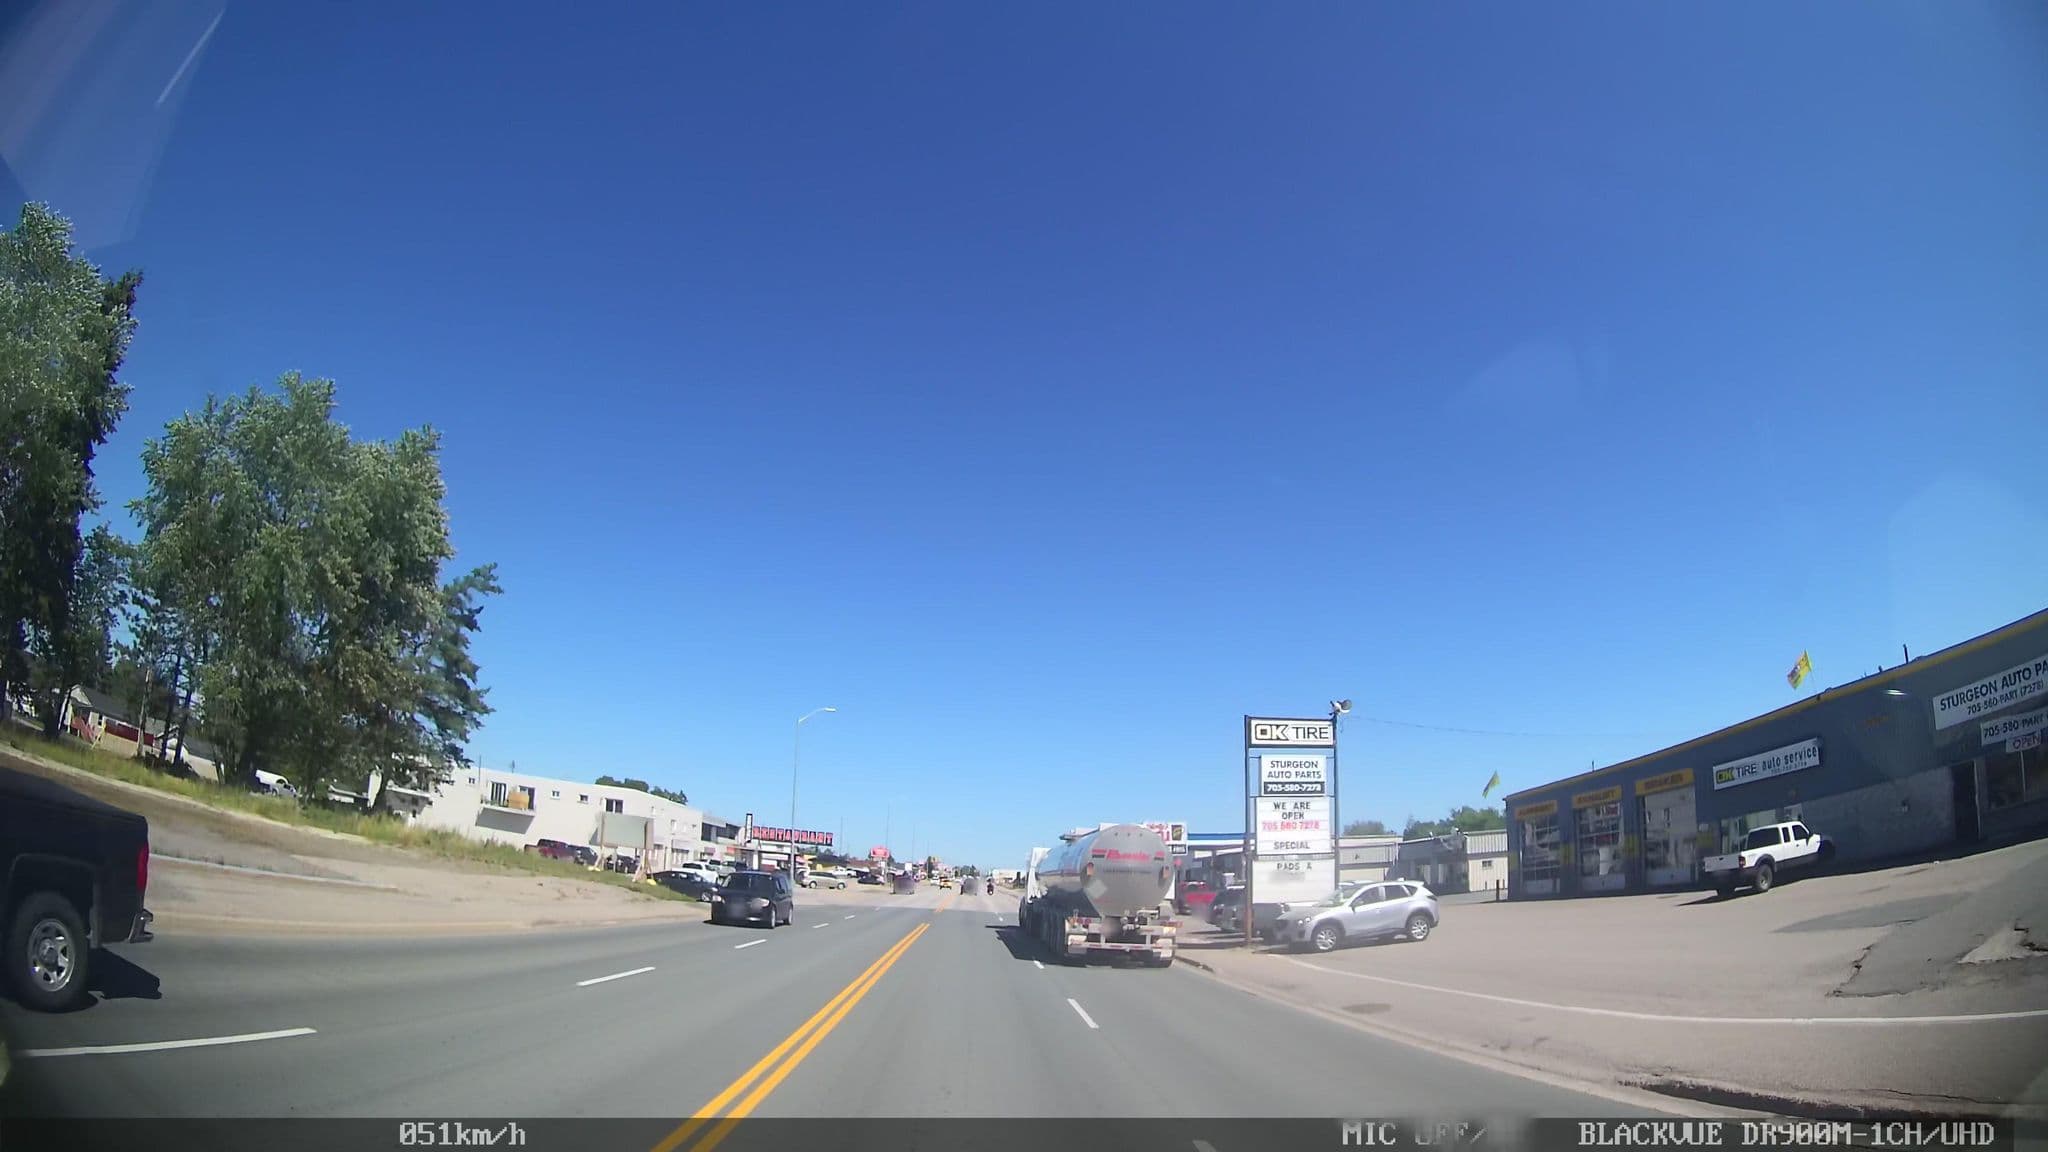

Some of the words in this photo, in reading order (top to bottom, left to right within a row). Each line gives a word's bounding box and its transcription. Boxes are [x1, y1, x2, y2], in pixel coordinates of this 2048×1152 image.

[1940, 680, 1998, 711] STURGEON
[2001, 667, 2032, 690] AUTO
[1255, 723, 1289, 741] OK
[1292, 726, 1329, 740] TIRE
[2012, 735, 2040, 749] OPEN
[1270, 760, 1318, 769] STURGEON
[1715, 767, 1735, 784] OK
[1736, 763, 1757, 778] TIRE
[1762, 757, 1781, 771] auto
[1784, 745, 1817, 765] service
[1267, 770, 1292, 779] AUTO
[1295, 770, 1322, 779] PARTS
[1273, 801, 1287, 810] WE
[1293, 801, 1311, 810] ARE
[1281, 811, 1305, 820] OPEN
[1273, 841, 1311, 850] SPECIAL
